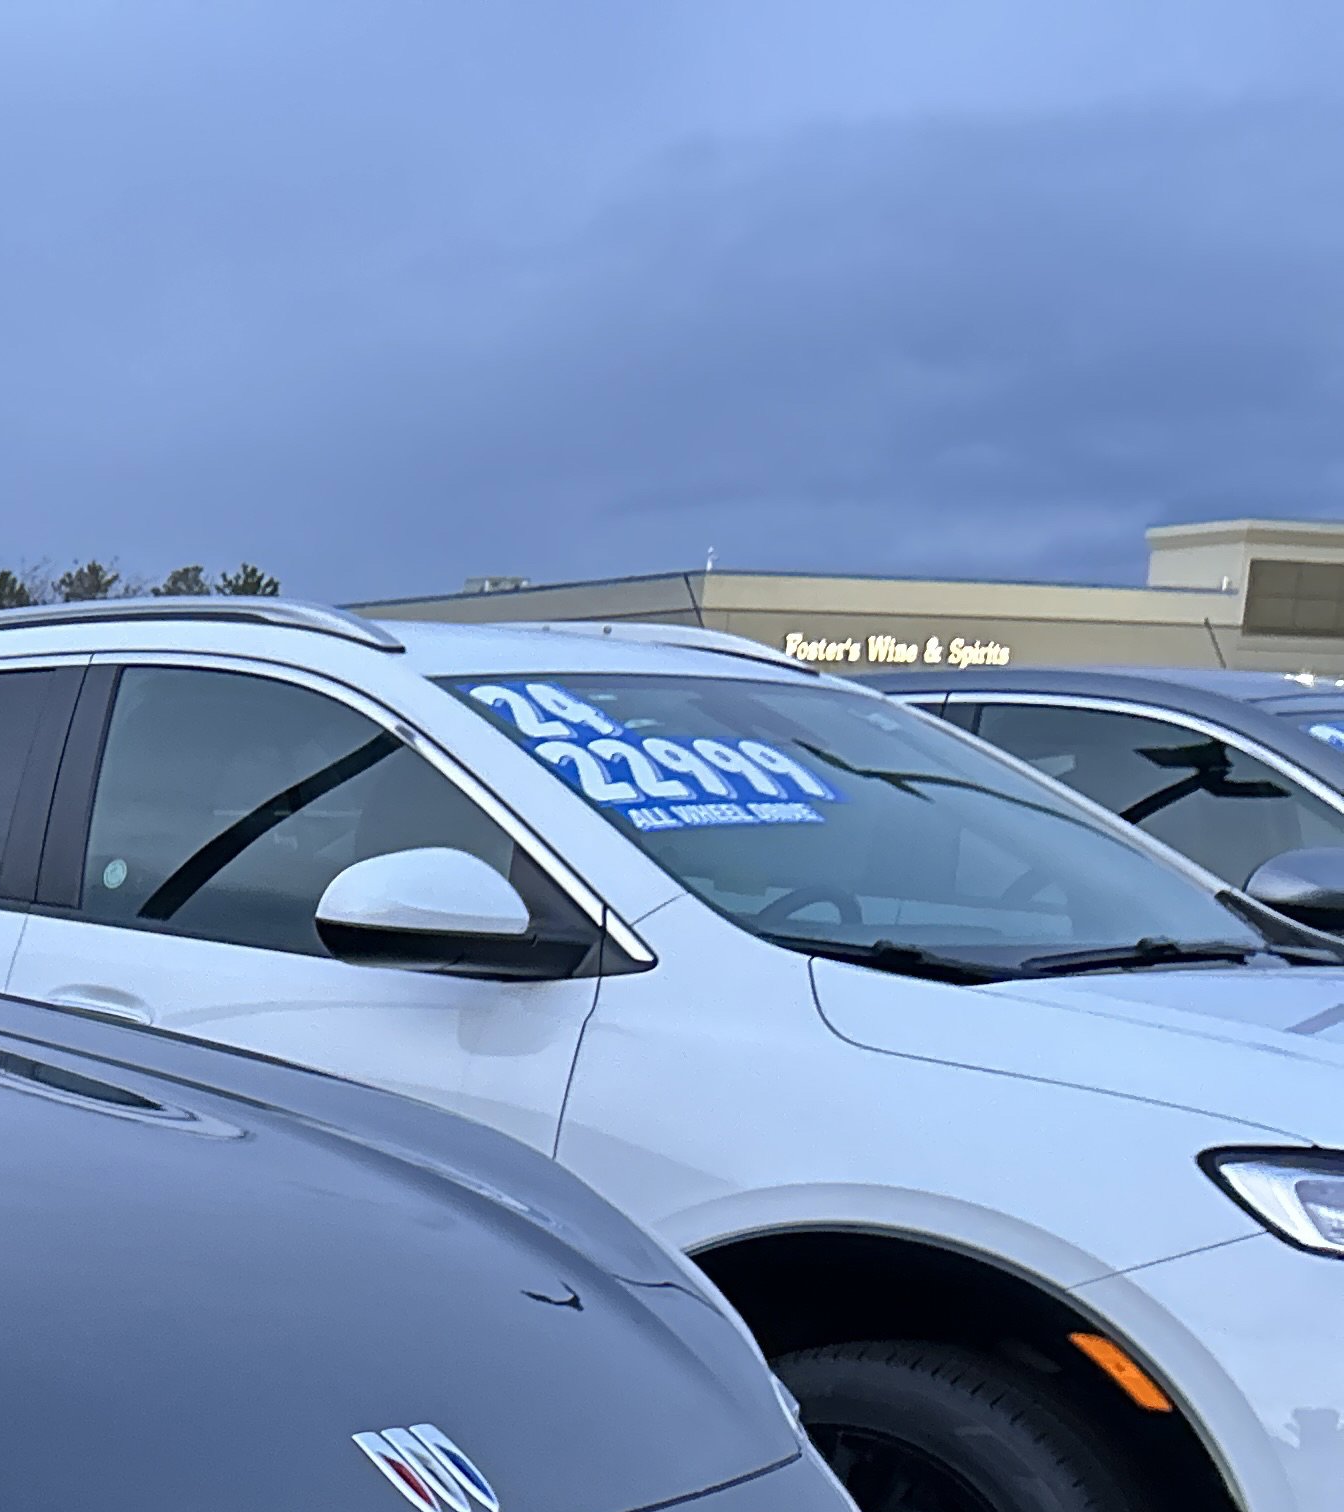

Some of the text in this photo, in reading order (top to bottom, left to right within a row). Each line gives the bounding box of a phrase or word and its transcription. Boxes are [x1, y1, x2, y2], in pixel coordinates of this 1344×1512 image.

[867, 635, 918, 662] Wine
[923, 636, 942, 663] &
[947, 637, 1010, 669] Spirits
[469, 682, 620, 738] 24
[534, 737, 836, 802] 22999
[627, 806, 682, 830] ALL
[670, 803, 759, 825] WHEEL
